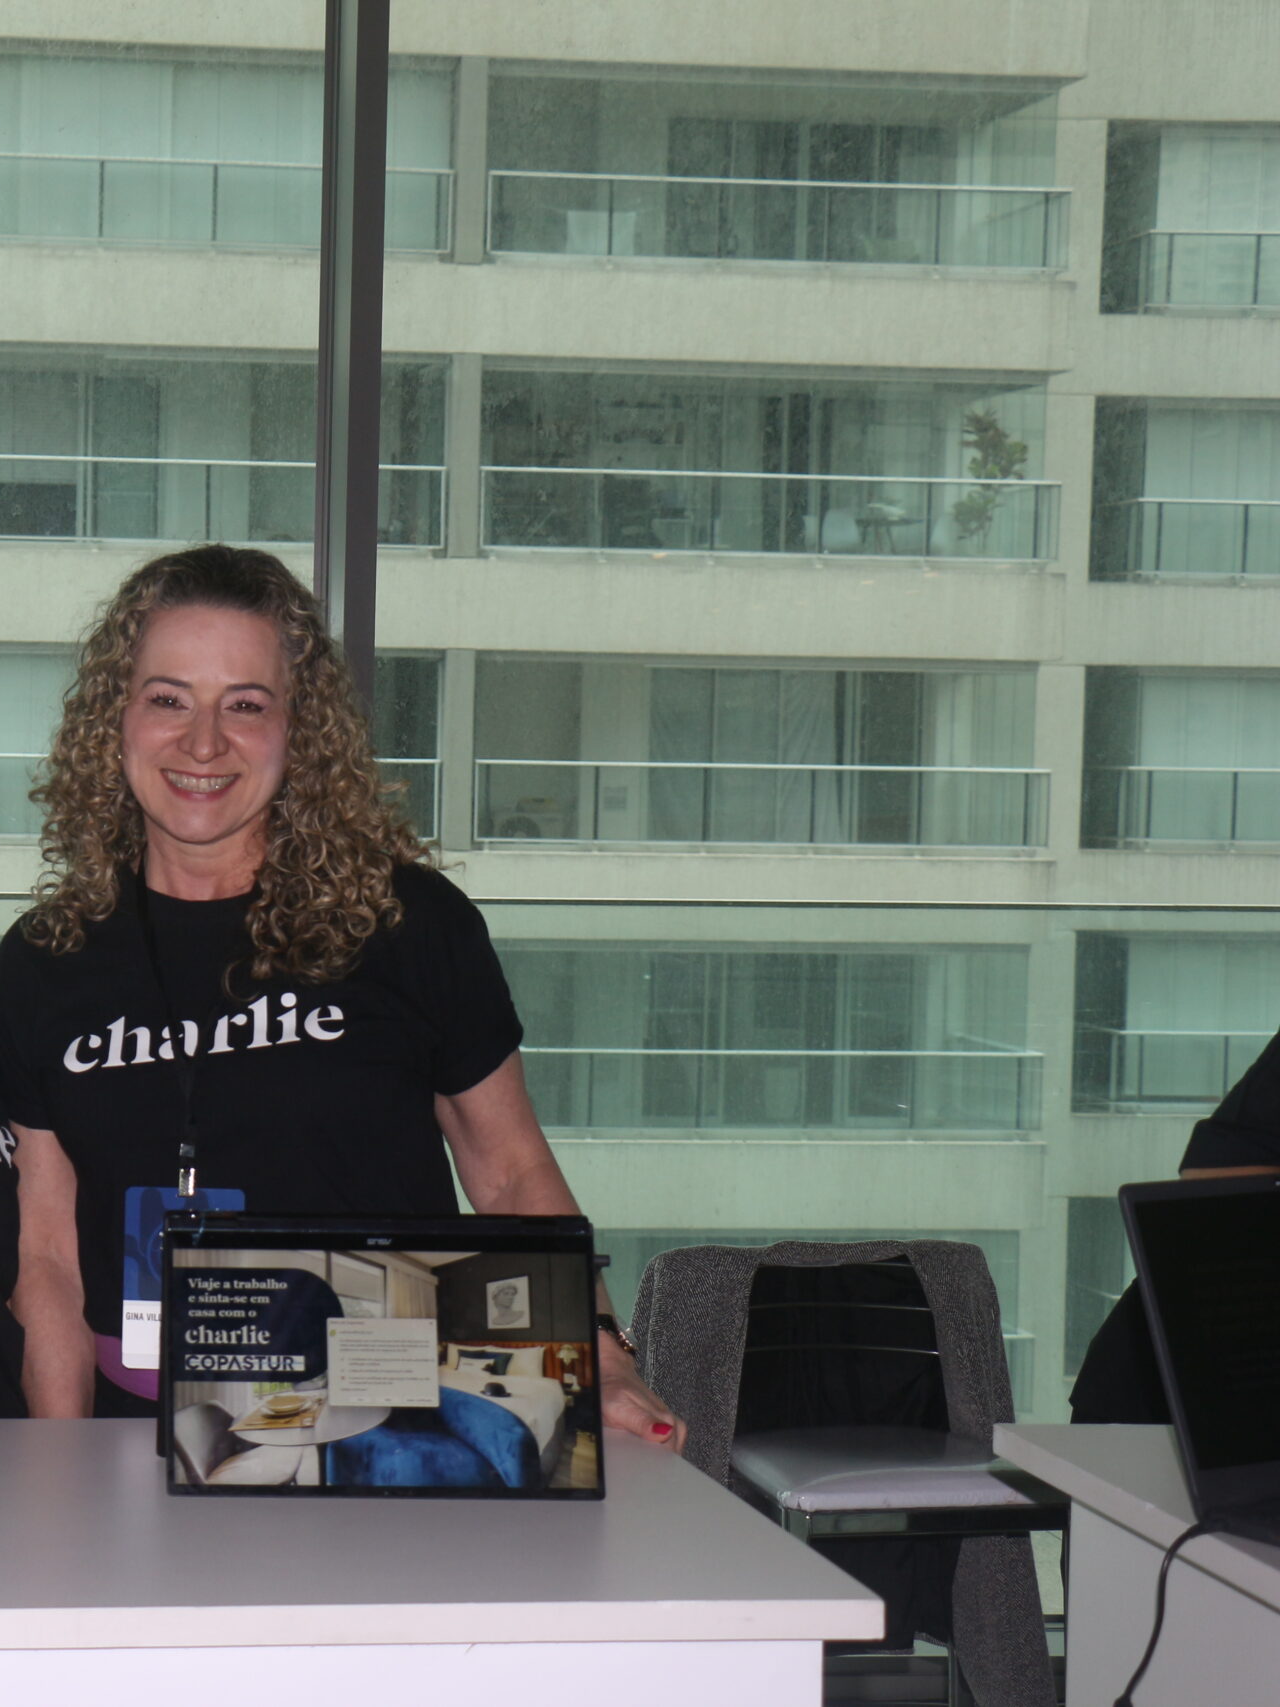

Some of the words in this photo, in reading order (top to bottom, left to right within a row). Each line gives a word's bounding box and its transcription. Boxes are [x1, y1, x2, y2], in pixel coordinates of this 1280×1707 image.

[63, 992, 345, 1073] charlie
[188, 1277, 221, 1291] Viaje
[223, 1280, 231, 1289] a
[233, 1278, 288, 1290] trabalho
[188, 1294, 196, 1303] e
[198, 1292, 247, 1303] sinta-se
[250, 1294, 270, 1304] em
[125, 1311, 144, 1321] GINA
[188, 1309, 216, 1318] casa
[218, 1309, 245, 1318] com
[248, 1309, 257, 1318] o
[184, 1324, 270, 1345] charlie
[185, 1355, 295, 1371] COPASTUR
